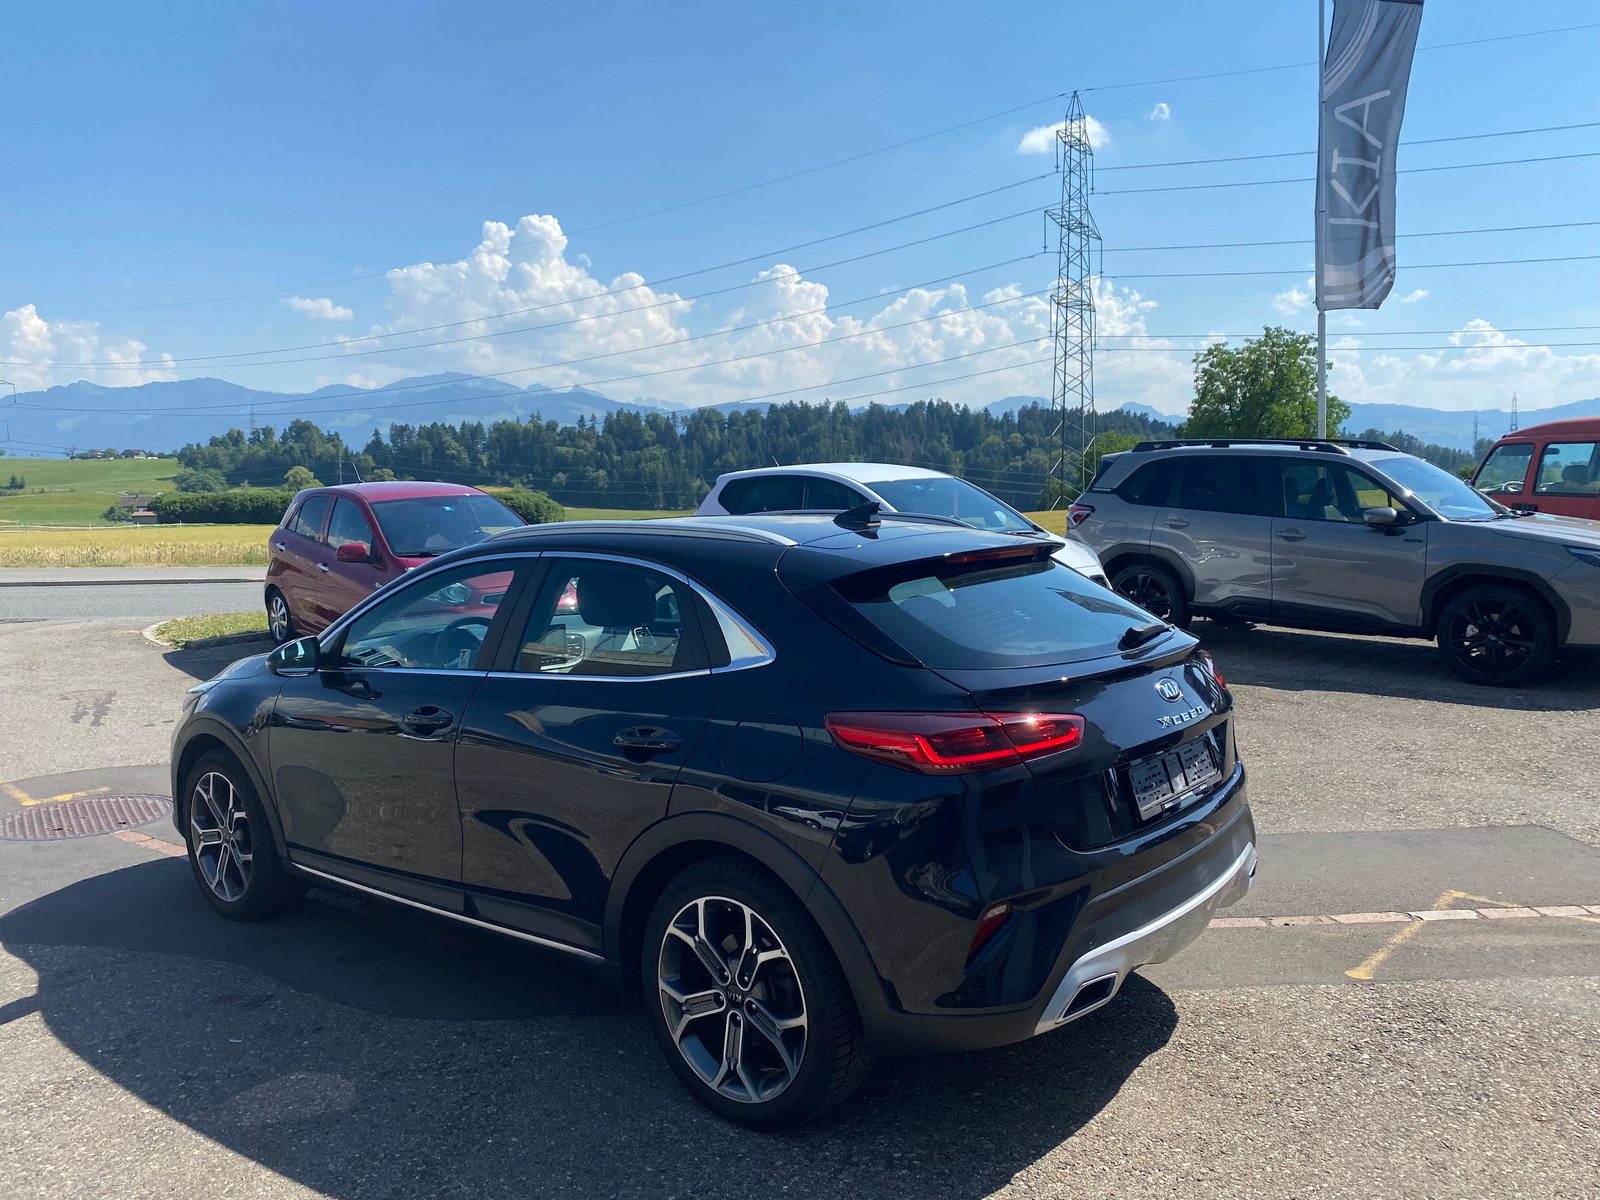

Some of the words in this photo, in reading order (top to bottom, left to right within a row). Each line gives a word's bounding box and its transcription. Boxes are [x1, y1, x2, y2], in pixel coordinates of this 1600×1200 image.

[1329, 89, 1391, 229] KIA
[1159, 680, 1180, 699] KIA
[1156, 705, 1205, 730] XCEED
[727, 990, 742, 1003] KIA
